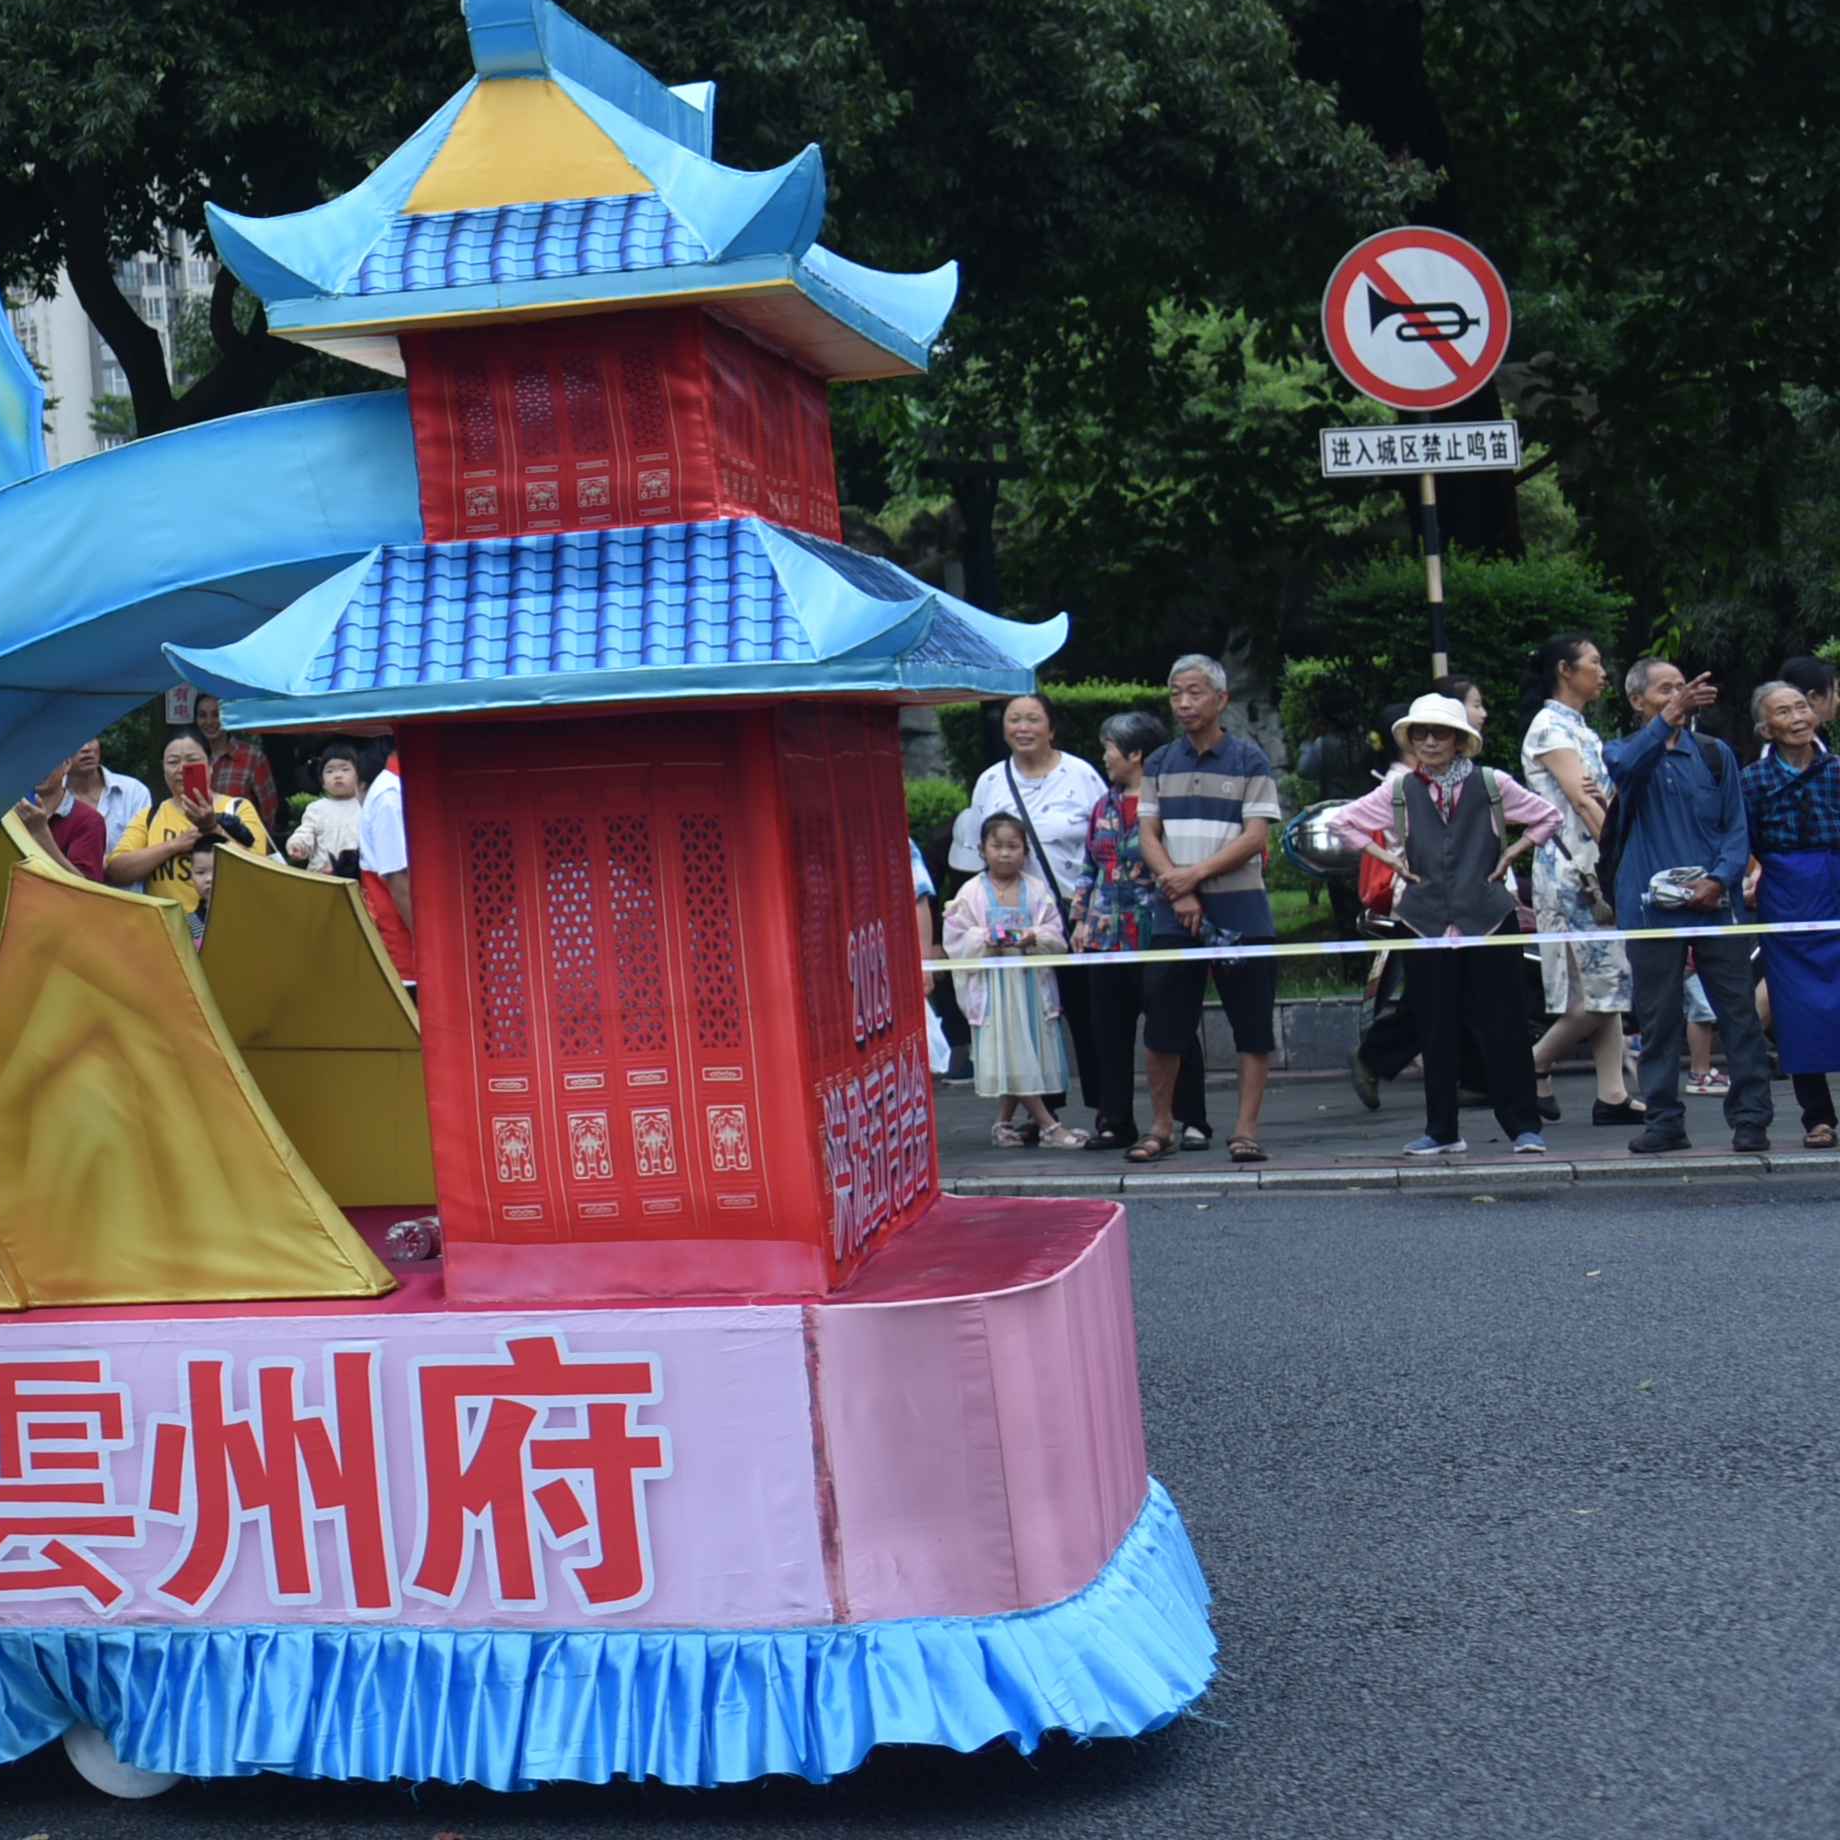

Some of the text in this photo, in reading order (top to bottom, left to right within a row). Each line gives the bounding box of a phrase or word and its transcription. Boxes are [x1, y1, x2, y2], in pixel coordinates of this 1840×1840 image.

[1331, 430, 1508, 467] 进入城区禁止鸣笛
[172, 687, 190, 718] 有电
[848, 918, 892, 1043] 2023
